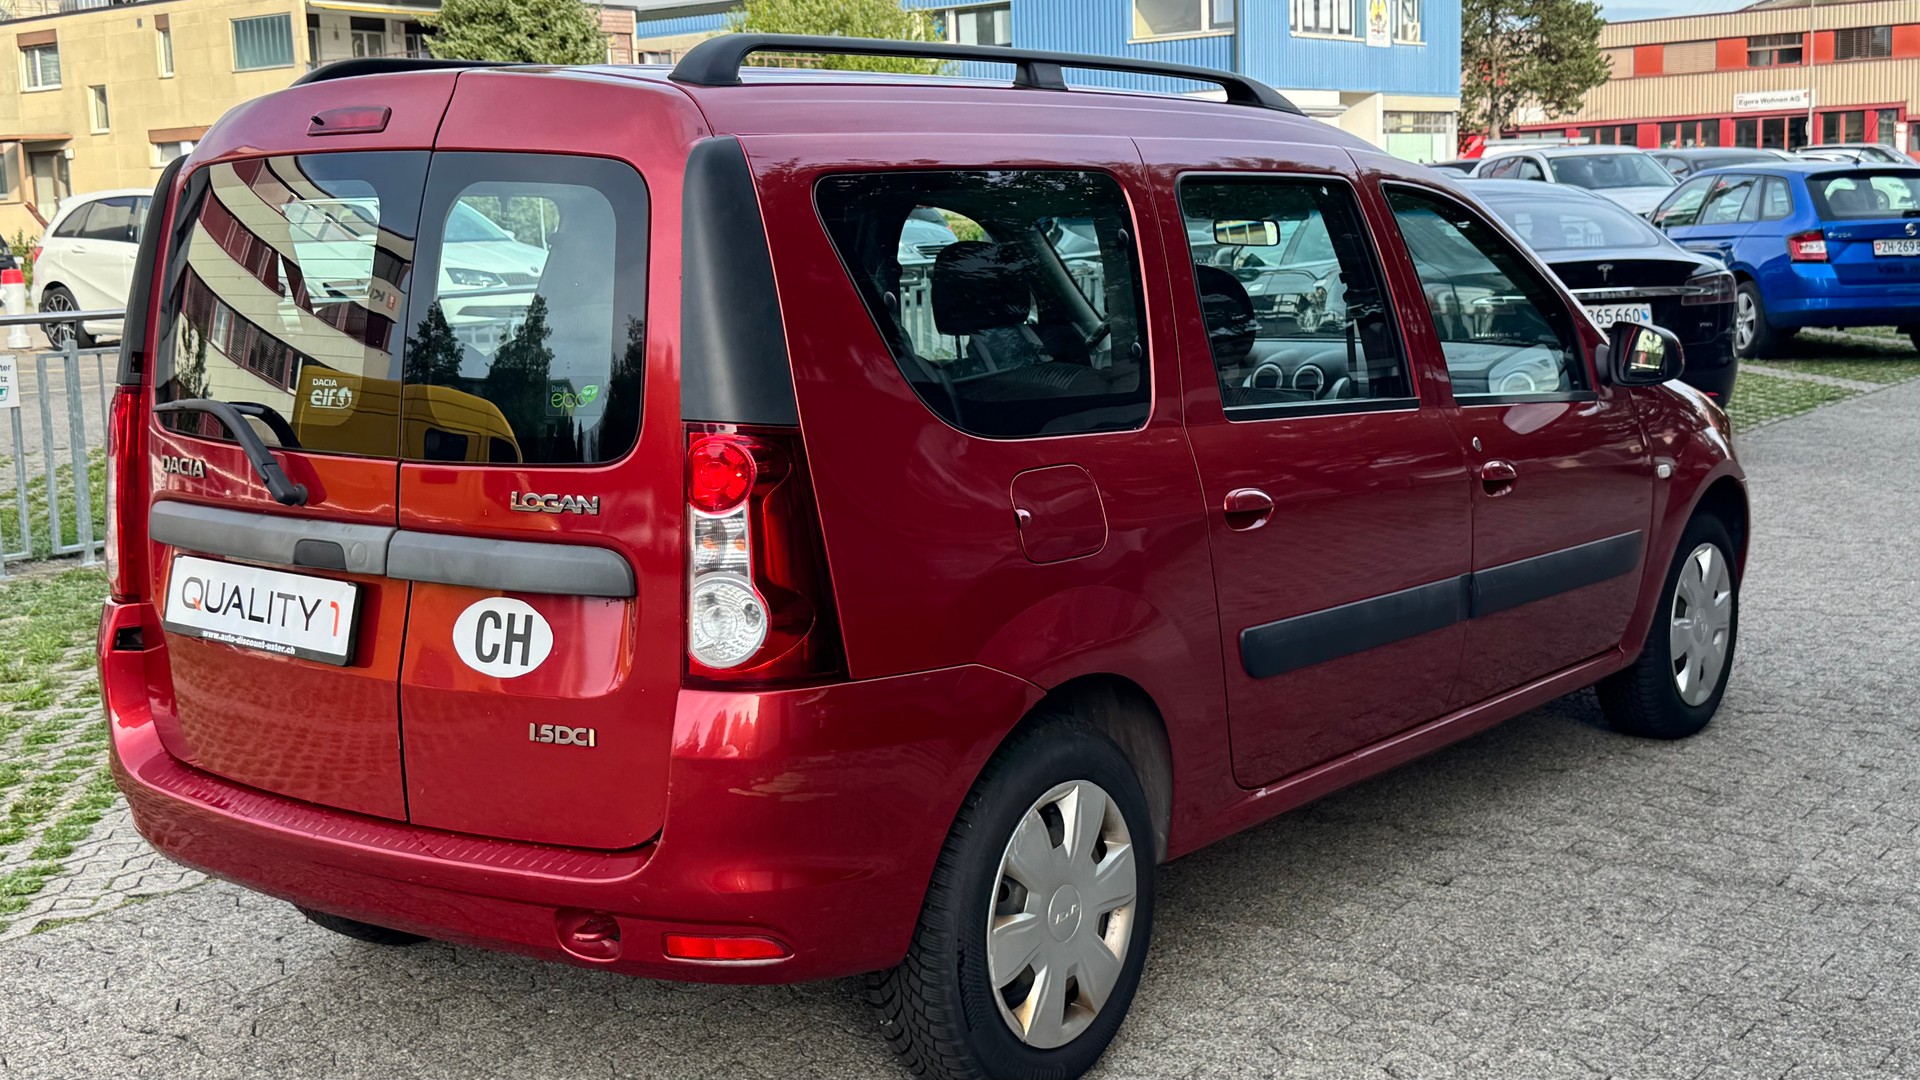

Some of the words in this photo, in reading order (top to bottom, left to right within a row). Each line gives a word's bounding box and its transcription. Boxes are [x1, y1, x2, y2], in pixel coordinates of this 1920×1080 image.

[312, 378, 338, 386] DACIA
[311, 389, 337, 406] elf
[161, 455, 205, 478] DACIA
[511, 491, 599, 515] LOGAN
[202, 630, 295, 655] www.auto-discount-uster.ch
[475, 610, 533, 666] CH
